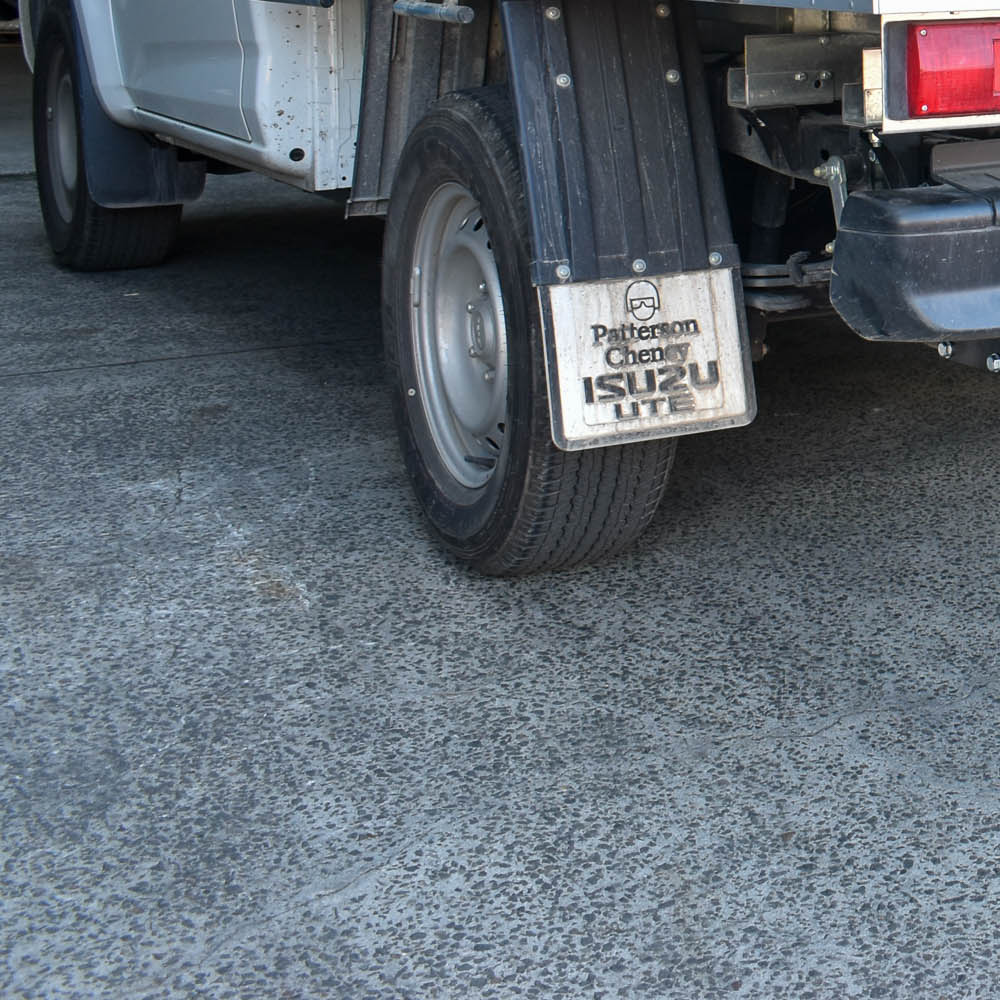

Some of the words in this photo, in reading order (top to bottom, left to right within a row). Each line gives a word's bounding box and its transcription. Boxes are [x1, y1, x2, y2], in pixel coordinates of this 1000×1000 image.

[591, 318, 700, 346] Patterson
[605, 342, 692, 370] Cheney
[583, 360, 719, 404] ISUZU
[615, 392, 696, 420] UTE
